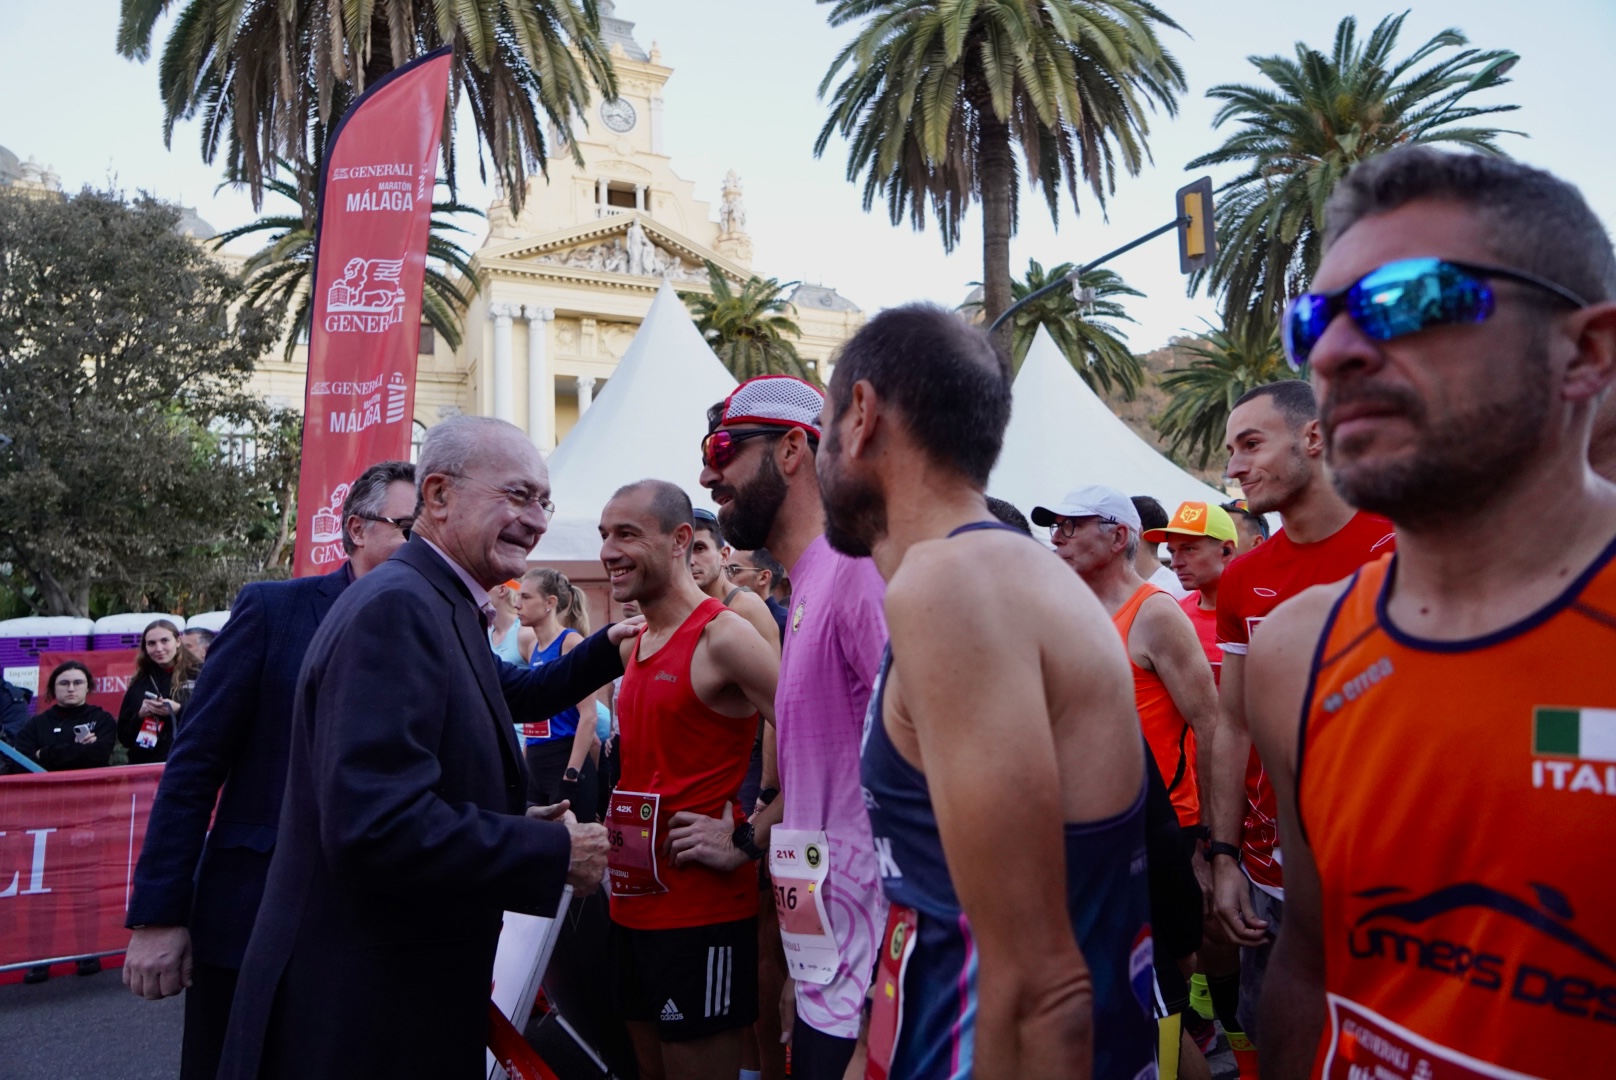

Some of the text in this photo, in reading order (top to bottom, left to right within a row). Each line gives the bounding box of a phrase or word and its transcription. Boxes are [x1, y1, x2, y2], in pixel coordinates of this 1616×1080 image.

[350, 164, 413, 179] GENERALI
[378, 181, 412, 191] MARATÓN
[346, 189, 413, 212] MÁLAGA
[325, 305, 405, 333] GENERLI
[331, 373, 384, 395] GENERLI
[616, 805, 633, 814] 42K
[776, 850, 796, 860] 21K
[660, 1013, 684, 1021] adidas
